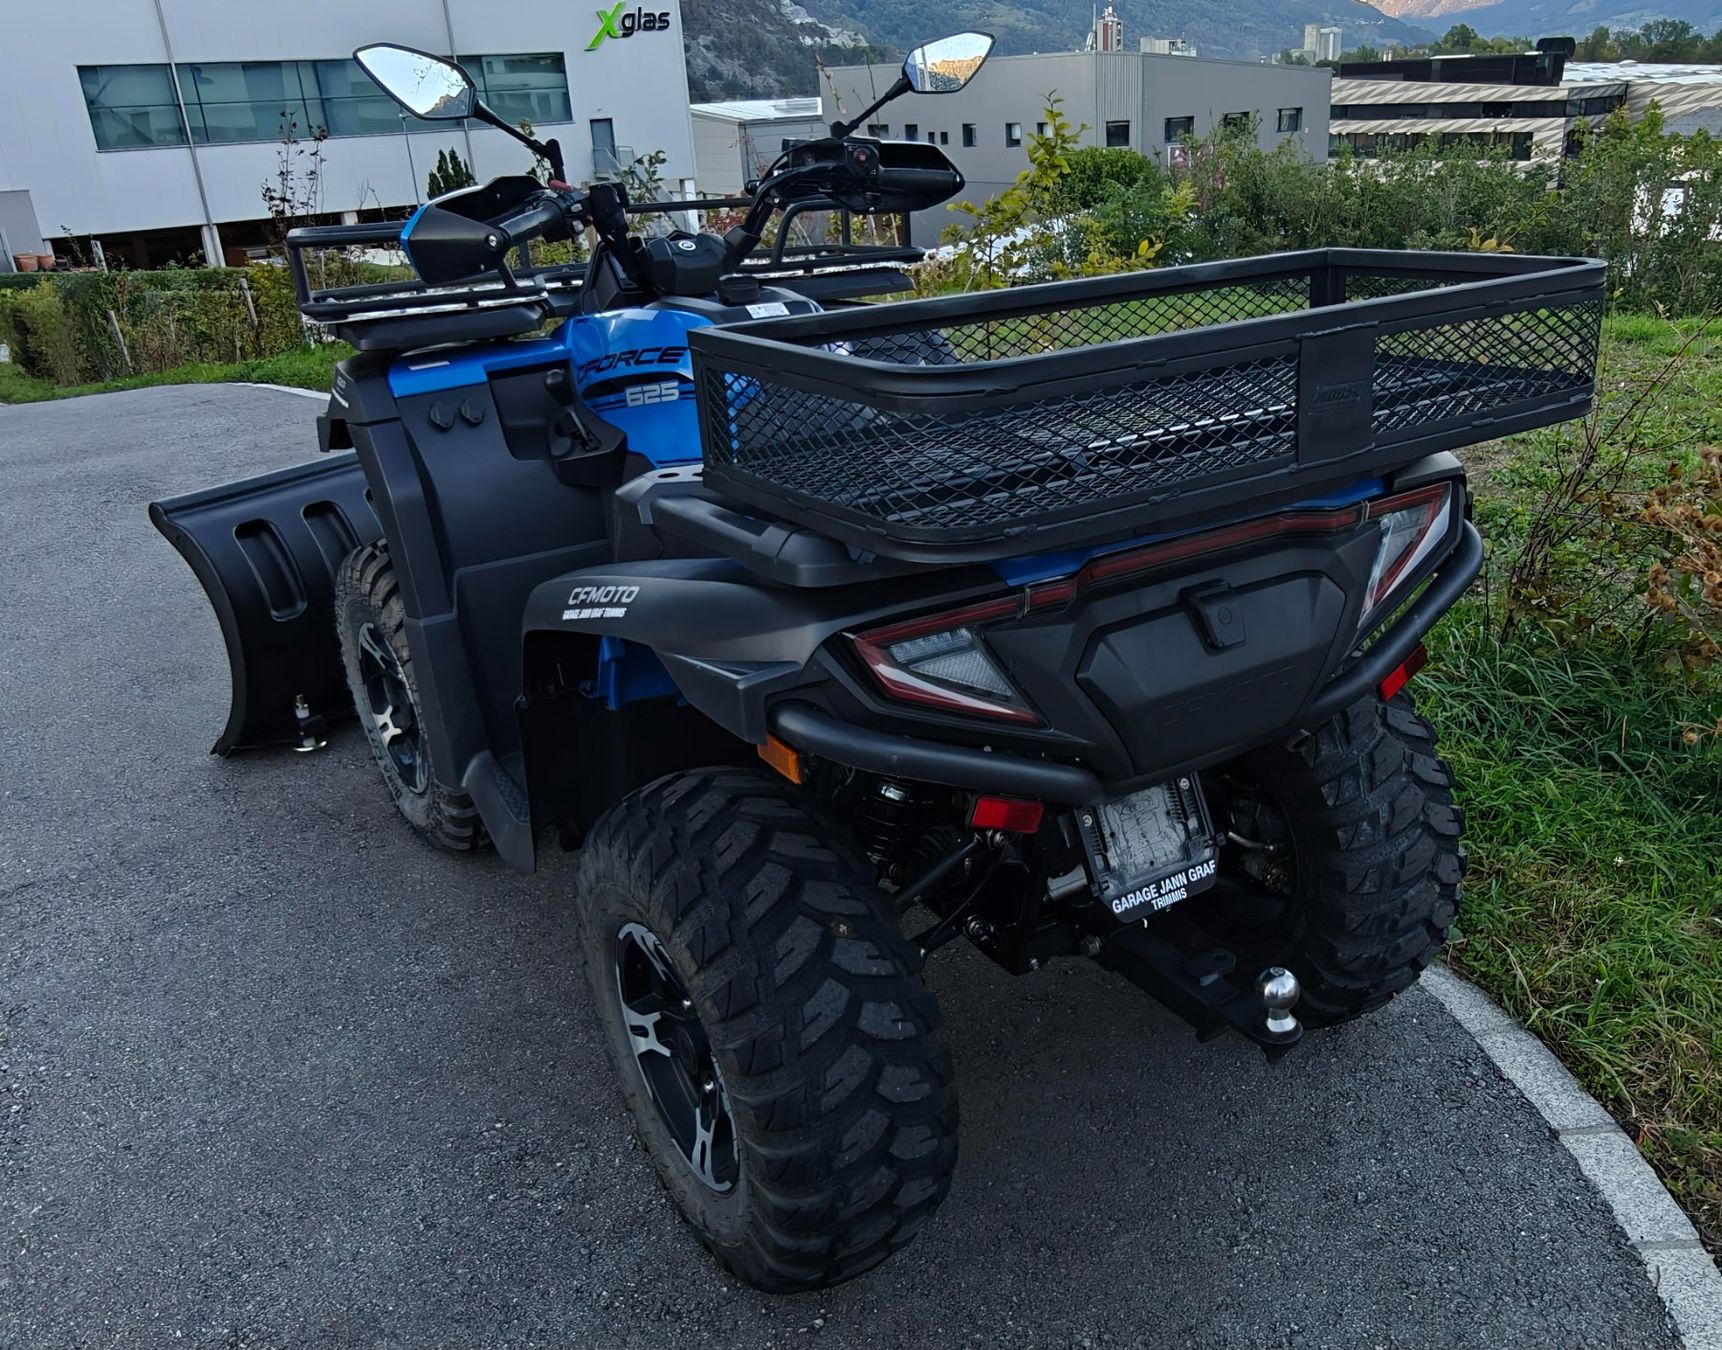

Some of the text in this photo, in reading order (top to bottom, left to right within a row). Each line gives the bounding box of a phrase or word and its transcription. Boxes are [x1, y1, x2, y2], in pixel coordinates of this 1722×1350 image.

[625, 381, 679, 407] 625
[568, 586, 640, 605] CFMOTO
[1112, 860, 1216, 914] GARAGE JANN GRAF
[1151, 887, 1187, 911] TRIMMIS
